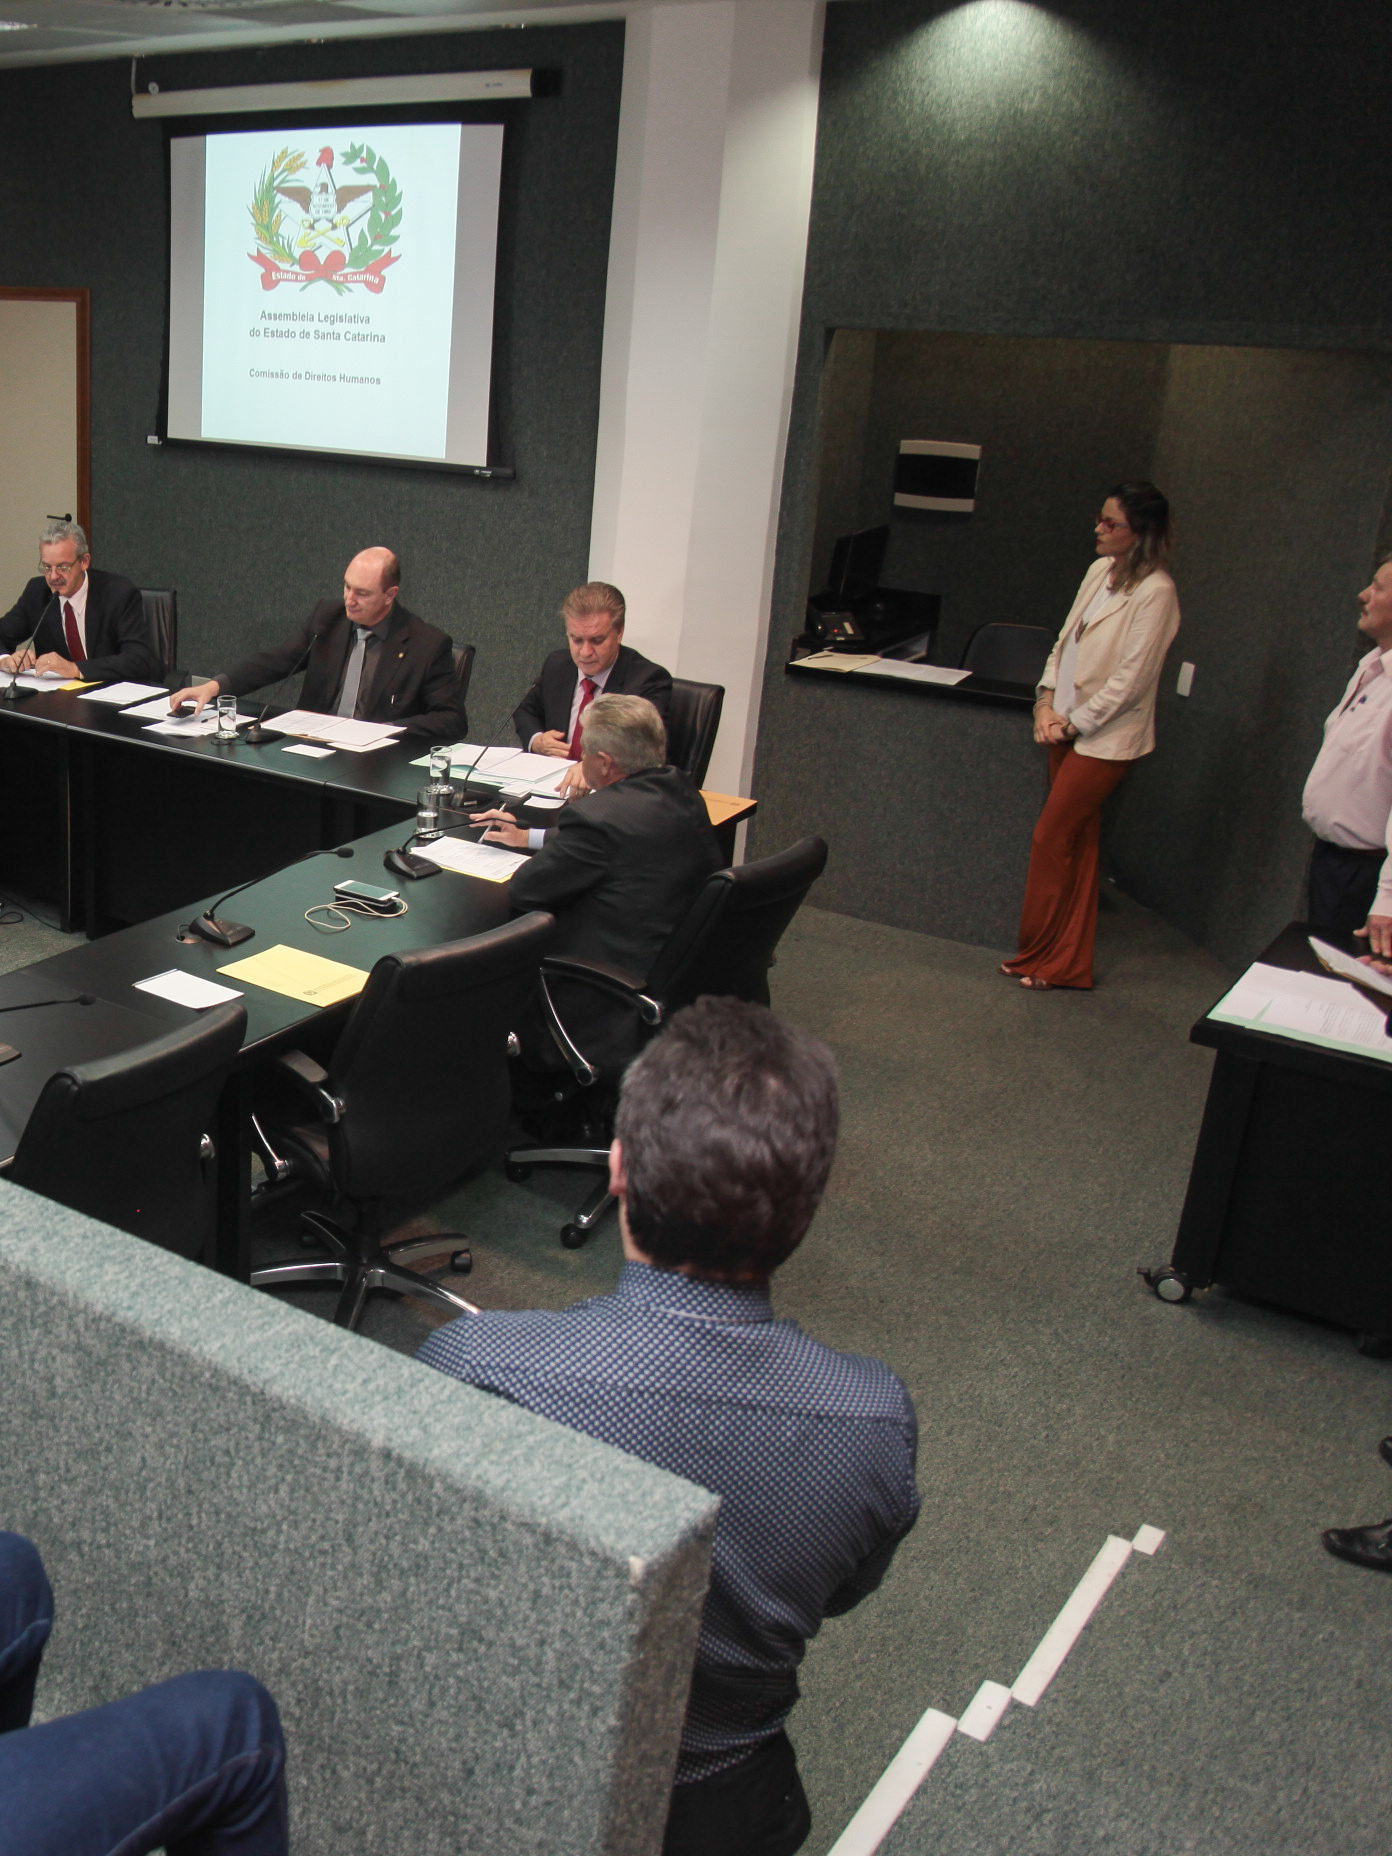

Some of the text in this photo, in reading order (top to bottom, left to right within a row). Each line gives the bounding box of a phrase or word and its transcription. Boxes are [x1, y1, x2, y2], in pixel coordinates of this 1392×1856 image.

[271, 271, 296, 281] Estado
[347, 271, 379, 285] Catarina
[317, 312, 370, 326] Legislativa
[249, 327, 386, 344] do Estado de Santa Catarina
[249, 368, 382, 386] Comissão de Direitos Humanos
